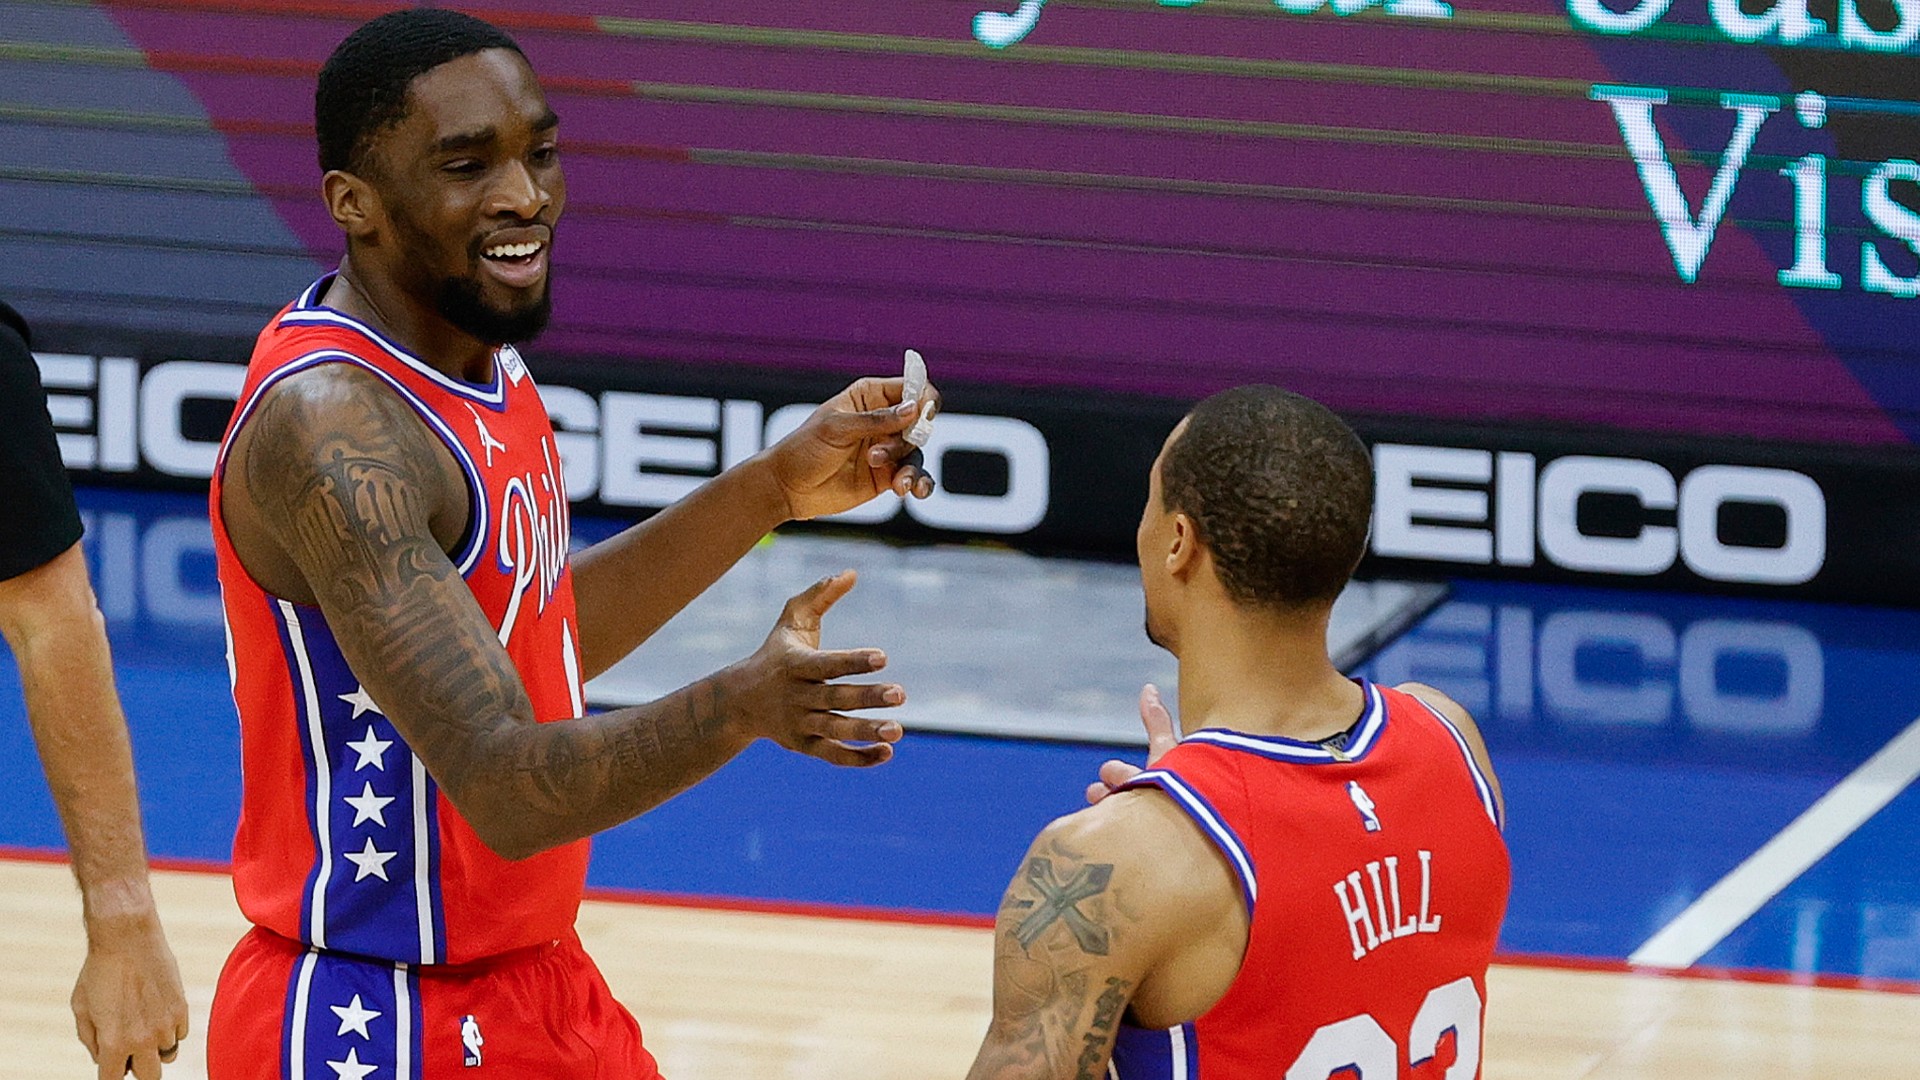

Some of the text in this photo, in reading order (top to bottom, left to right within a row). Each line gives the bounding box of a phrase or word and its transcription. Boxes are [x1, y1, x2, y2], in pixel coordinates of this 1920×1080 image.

[1588, 84, 1920, 297] Vis
[32, 352, 249, 479] EIC
[1372, 443, 1827, 586] EICO
[1333, 849, 1441, 960] HILL
